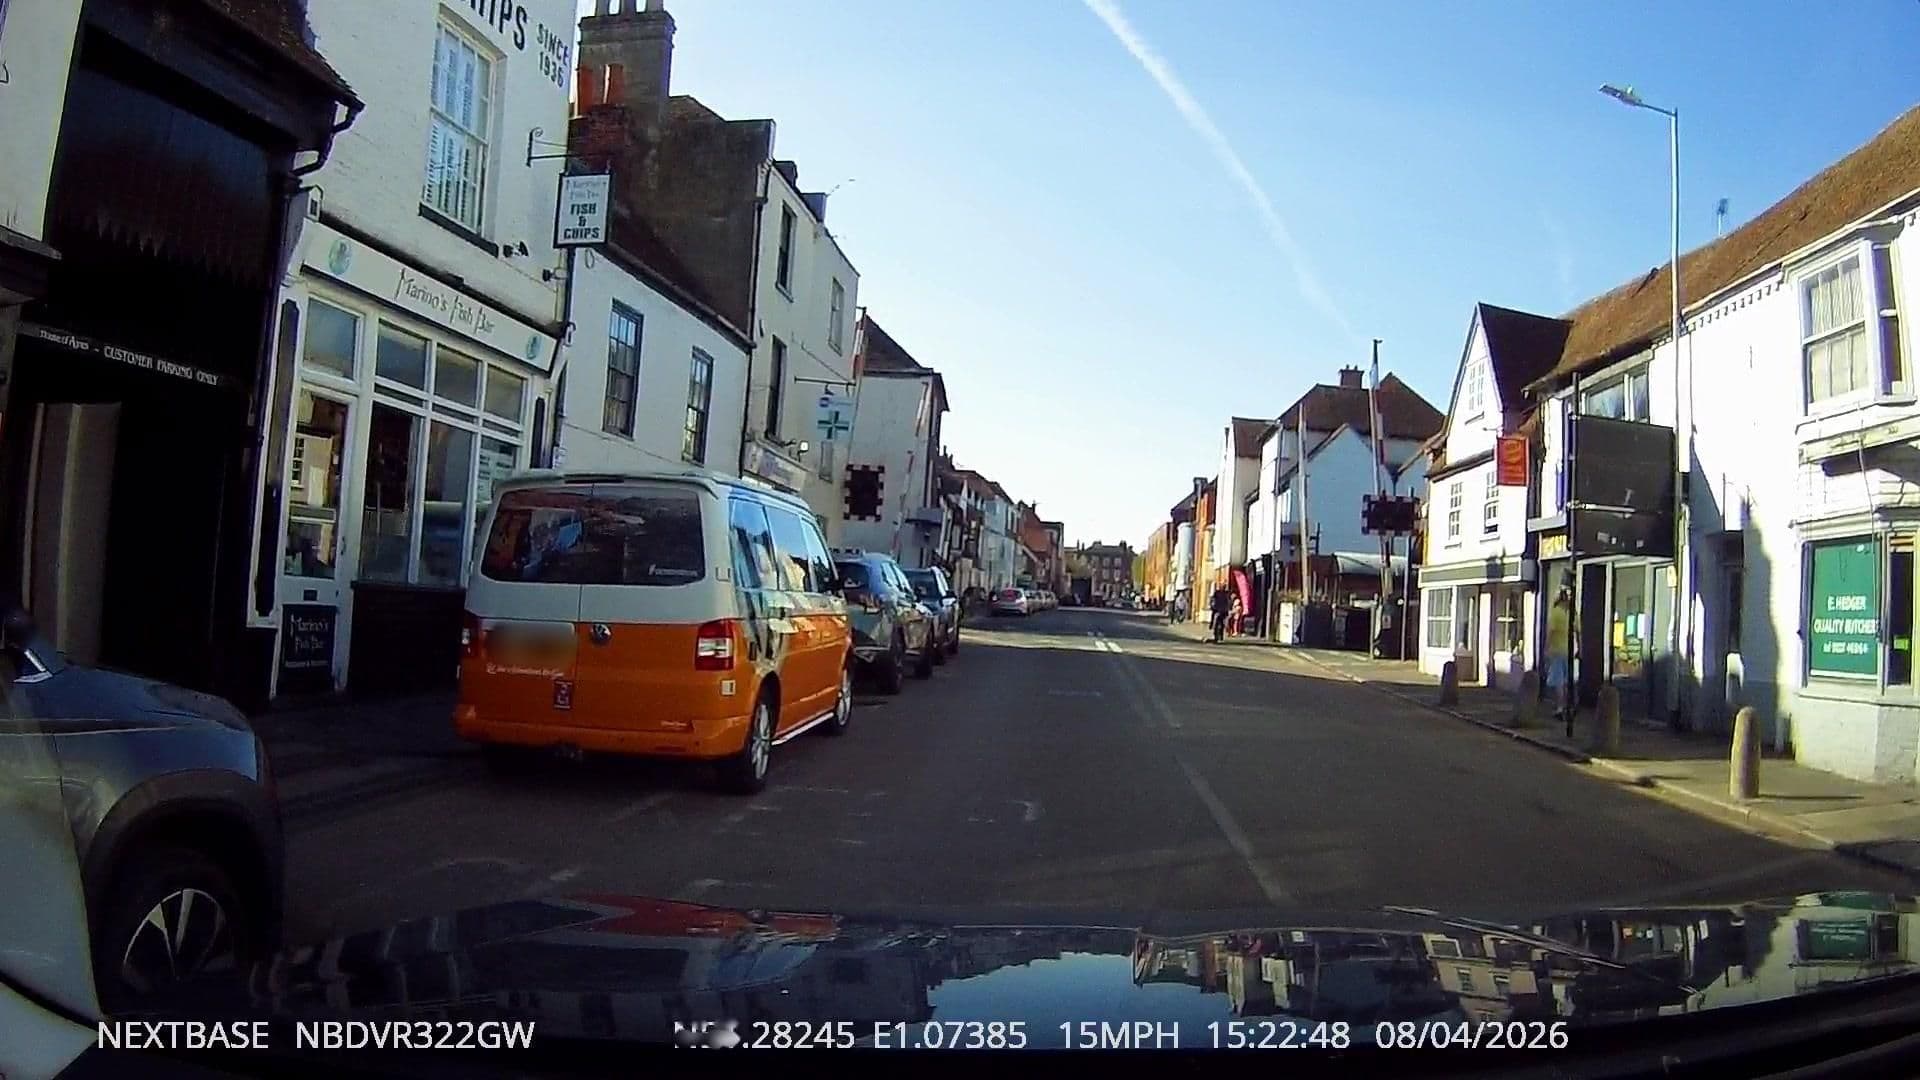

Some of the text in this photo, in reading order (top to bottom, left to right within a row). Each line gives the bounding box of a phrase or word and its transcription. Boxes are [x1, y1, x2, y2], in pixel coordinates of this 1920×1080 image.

[537, 24, 568, 66] SINCE
[570, 203, 597, 215] FISH
[564, 227, 601, 239] CHIPS
[394, 268, 448, 312] Marino's
[104, 346, 153, 369] CUSTOMER
[197, 370, 219, 386] ONLY
[1814, 619, 1843, 634] QUALITY
